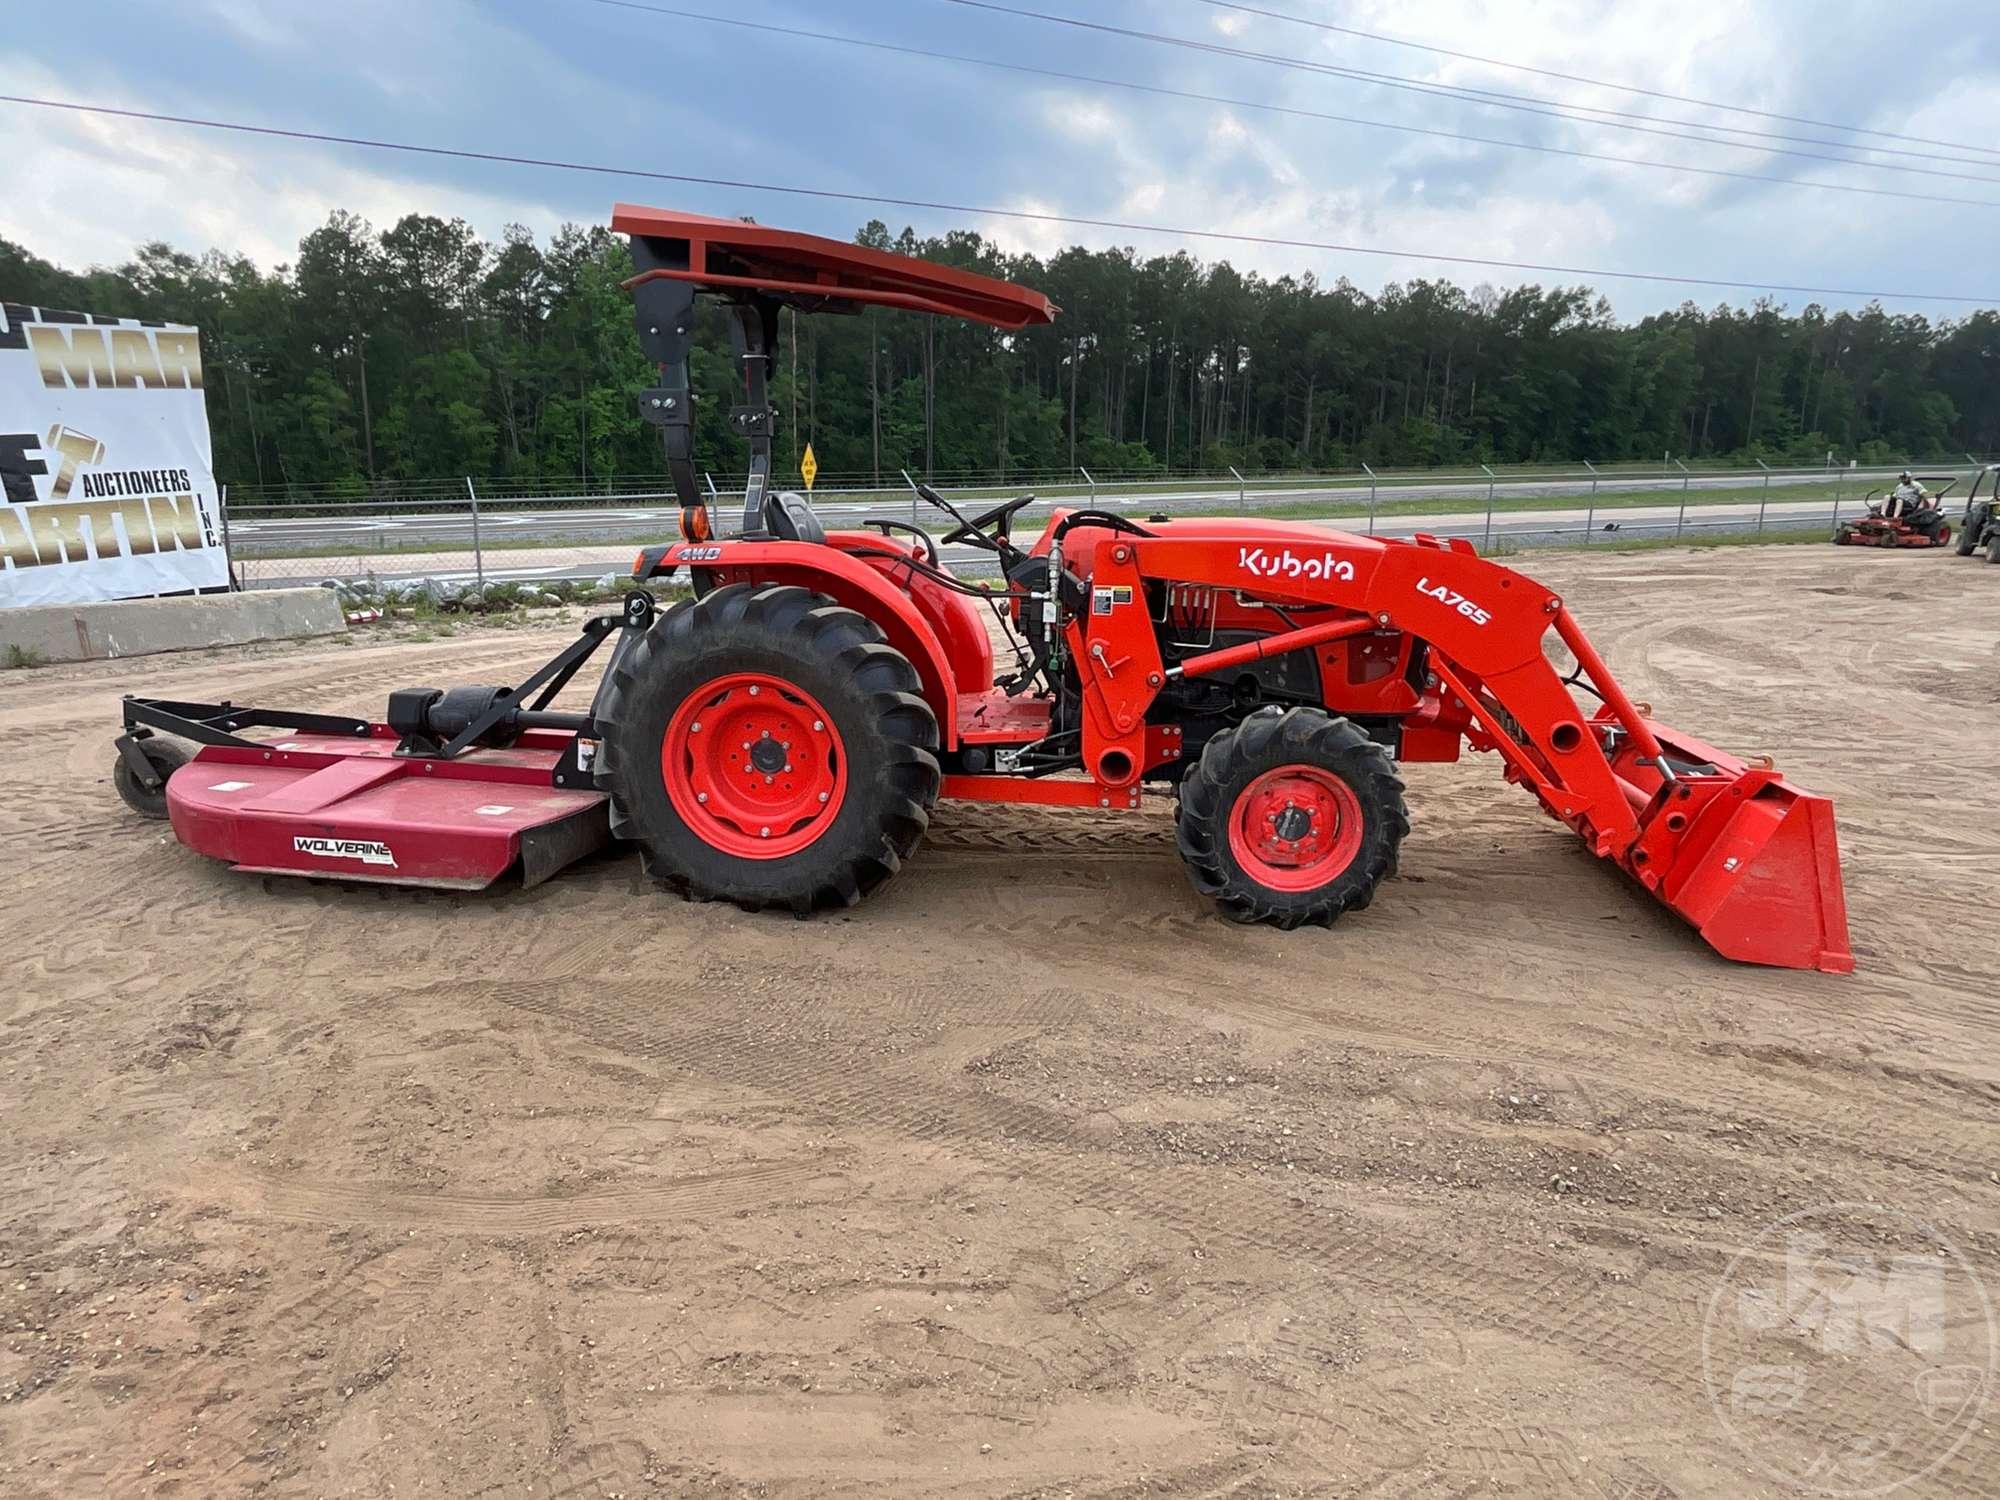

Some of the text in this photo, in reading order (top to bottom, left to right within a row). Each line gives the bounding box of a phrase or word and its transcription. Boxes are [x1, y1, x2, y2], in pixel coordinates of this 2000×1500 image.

[82, 469, 191, 498] AUCTIONEERS
[675, 547, 721, 560] 4WD
[1238, 547, 1355, 581] Kubota
[1415, 576, 1493, 626] LA765
[296, 839, 391, 856] WOLVERINE
